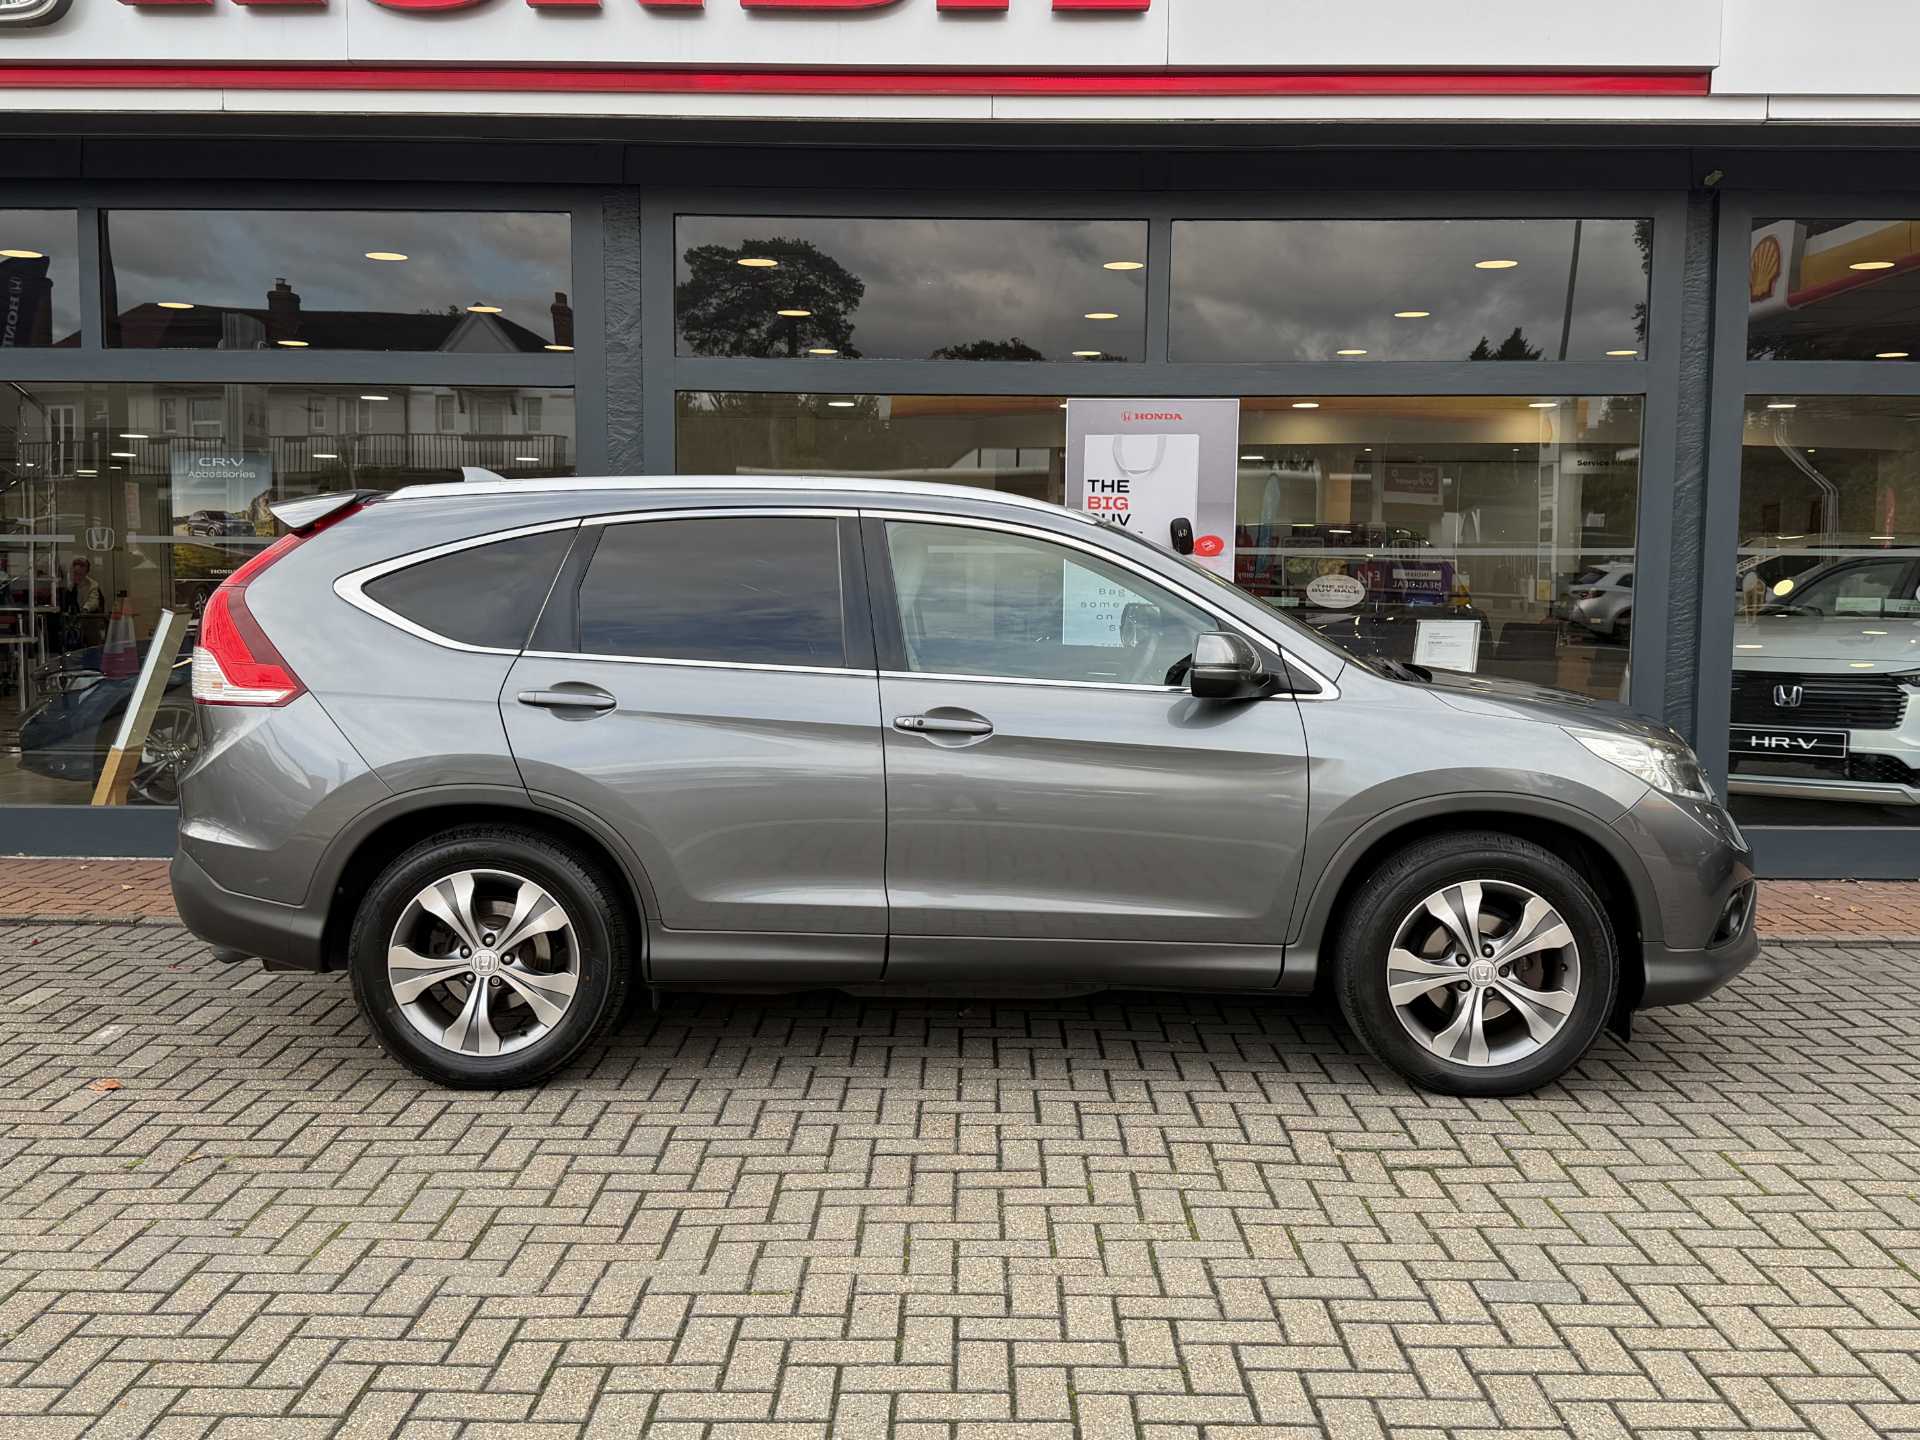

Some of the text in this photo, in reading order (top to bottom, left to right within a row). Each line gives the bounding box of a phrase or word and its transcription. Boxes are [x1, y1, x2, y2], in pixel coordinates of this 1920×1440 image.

[1135, 412, 1184, 421] HONDA
[1576, 458, 1610, 467] Service
[188, 470, 257, 480] Accessories
[1087, 479, 1130, 493] THE
[1087, 495, 1129, 511] BIG
[1090, 512, 1131, 527] UV
[210, 568, 234, 576] HOND
[1751, 735, 1818, 750] HR-V
